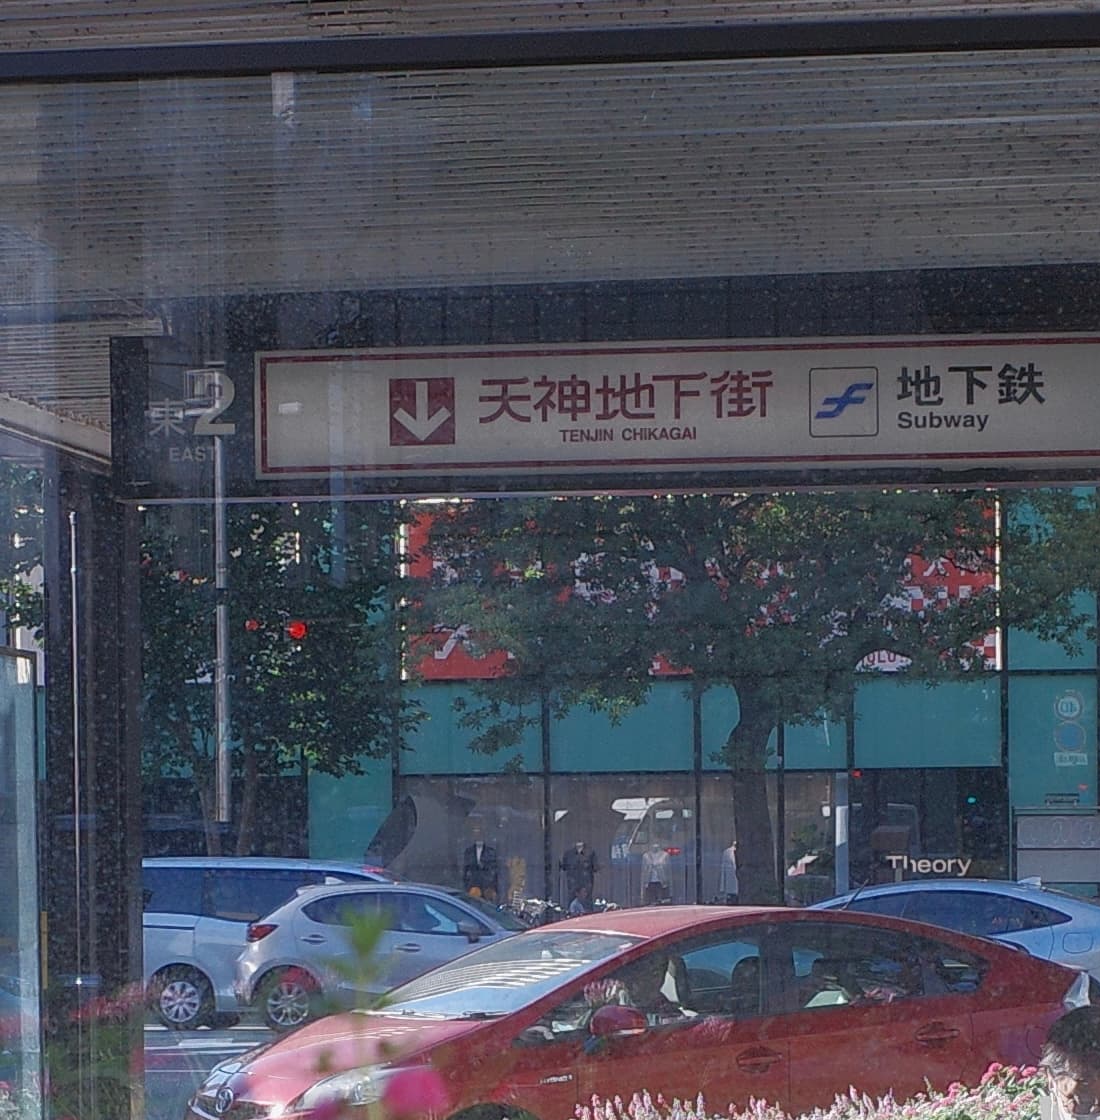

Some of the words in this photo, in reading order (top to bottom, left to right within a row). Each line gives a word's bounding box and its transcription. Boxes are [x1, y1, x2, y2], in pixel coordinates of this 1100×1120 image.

[896, 362, 1046, 406] 地下鉄
[478, 370, 774, 424] 天神地下街
[897, 411, 990, 432] Subway
[559, 429, 614, 442] TENJIN
[621, 427, 697, 442] CHIKAGAI
[885, 855, 972, 876] Theory
